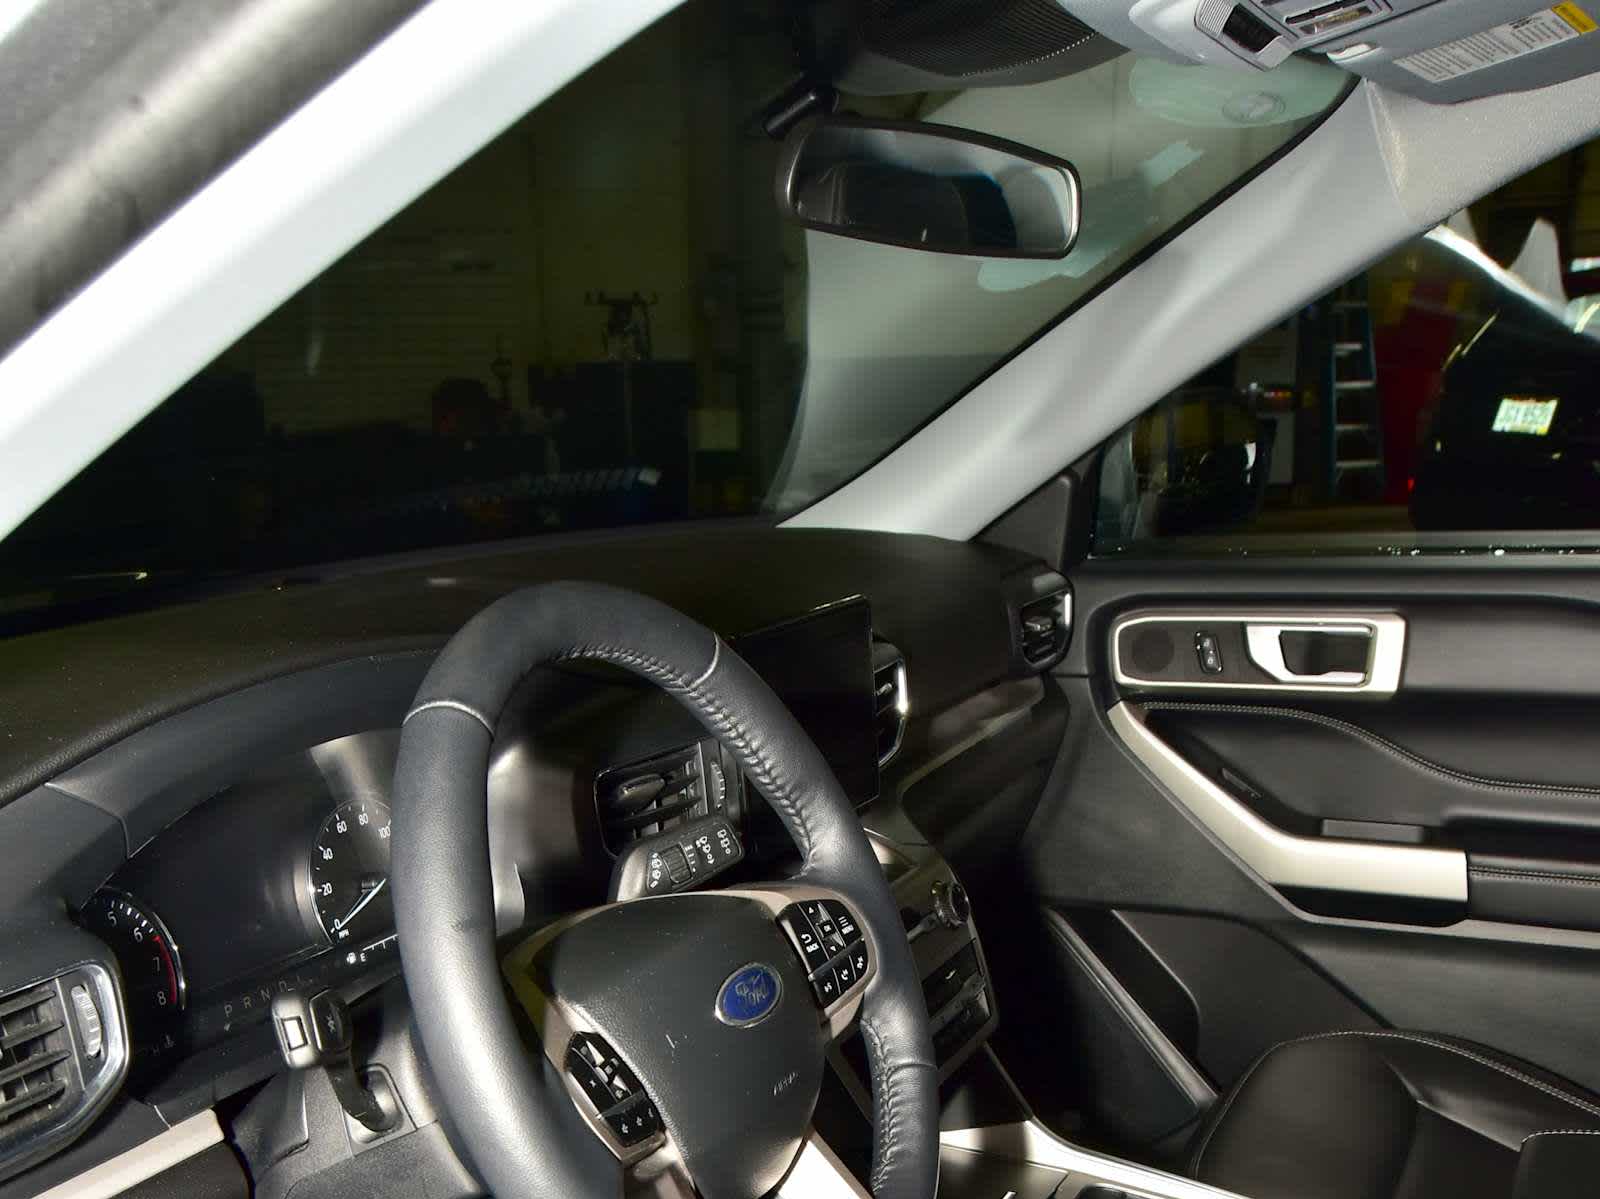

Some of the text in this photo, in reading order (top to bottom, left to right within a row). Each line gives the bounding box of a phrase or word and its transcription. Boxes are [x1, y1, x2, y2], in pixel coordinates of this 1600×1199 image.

[357, 812, 370, 827] 80
[335, 820, 348, 835] 60
[377, 825, 392, 839] 100
[322, 847, 334, 861] 40
[320, 883, 333, 896] 20
[107, 911, 118, 927] 5
[132, 927, 144, 943] 6
[152, 955, 162, 973] 7
[156, 991, 167, 1006] 8
